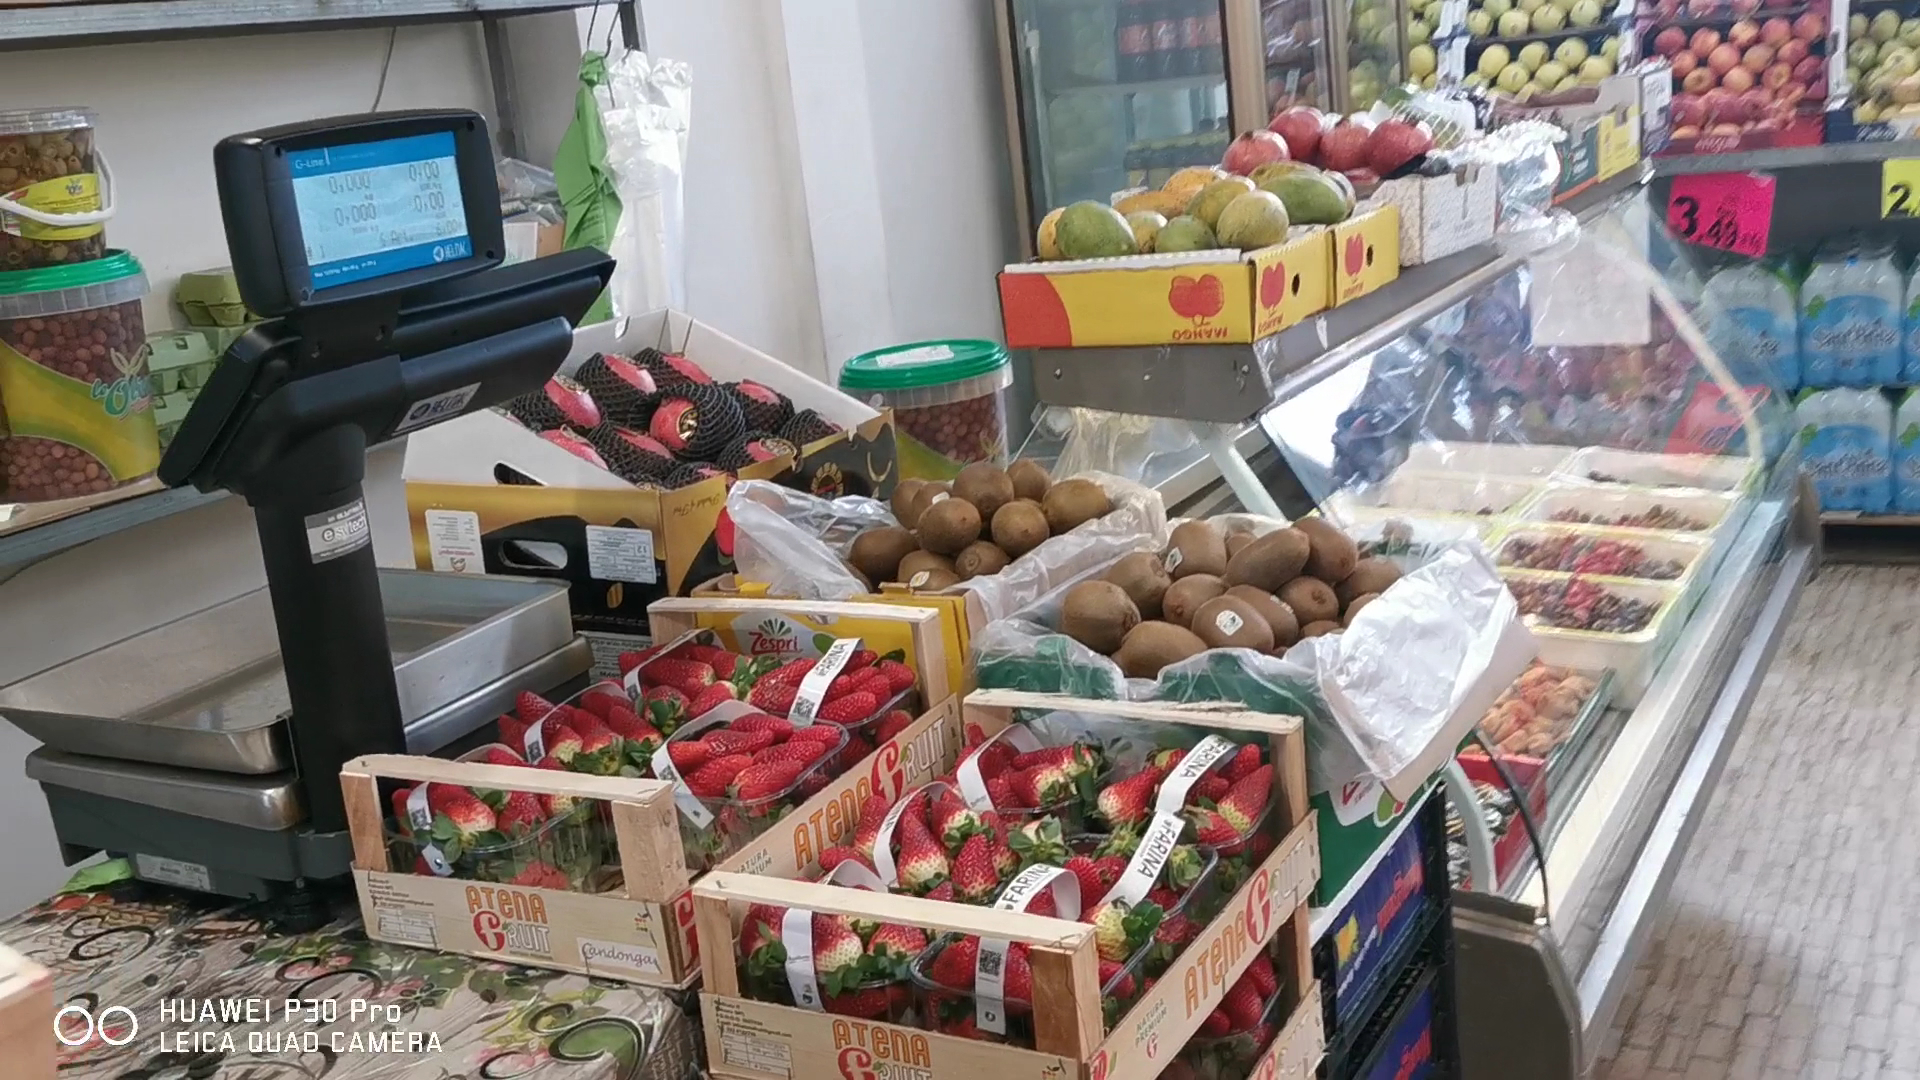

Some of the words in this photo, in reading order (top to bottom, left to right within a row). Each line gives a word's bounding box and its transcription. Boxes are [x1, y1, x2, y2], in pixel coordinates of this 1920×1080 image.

[1171, 326, 1228, 341] MANGO
[748, 632, 803, 656] Zespri
[795, 776, 871, 871] ATENA
[1137, 823, 1176, 879] FARINA
[465, 885, 548, 925] ATENA
[1184, 911, 1248, 1021] ATENA
[832, 1018, 932, 1068] ATENA
